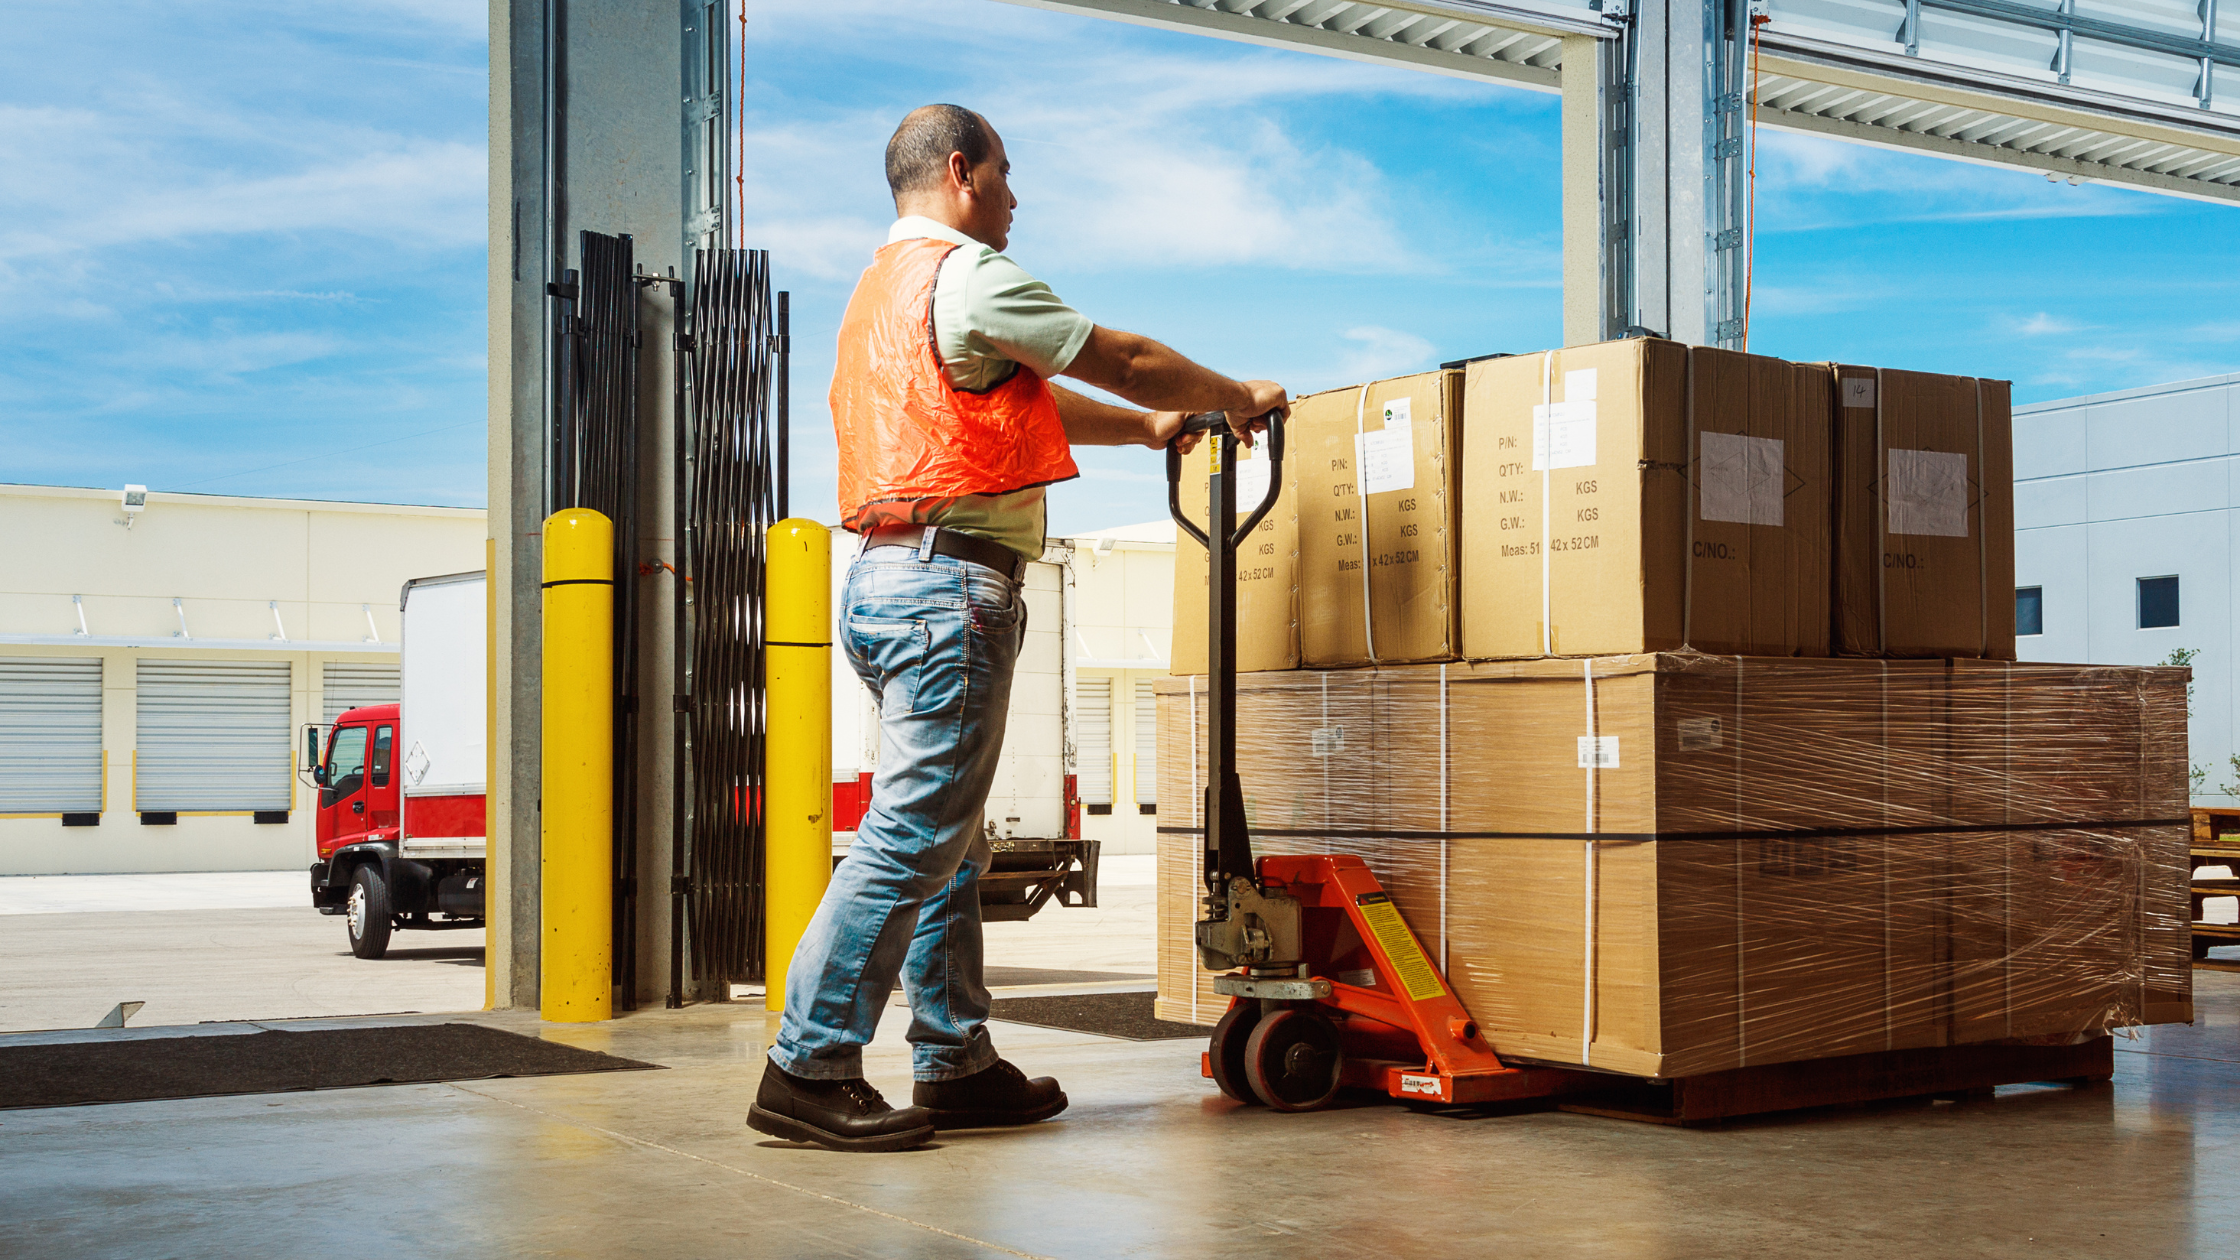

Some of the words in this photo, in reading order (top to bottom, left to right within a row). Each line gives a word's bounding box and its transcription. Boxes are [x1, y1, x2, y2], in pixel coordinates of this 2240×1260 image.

[1853, 384, 1866, 398] 14
[1499, 436, 1517, 450] P/N:
[1331, 458, 1348, 471] P/N:
[1499, 462, 1523, 477] Q'TY:
[1333, 483, 1354, 497] Q'TY:
[1499, 490, 1523, 504] N.W.:
[1576, 480, 1597, 495] KGS
[1335, 508, 1355, 521] N.W.:
[1398, 498, 1416, 512] KGS
[1258, 519, 1274, 532] KGS
[1500, 516, 1525, 530] G.W.:
[1577, 507, 1599, 522] KGS
[1336, 533, 1357, 546] G.W.:
[1400, 524, 1418, 538] KGS
[1259, 543, 1274, 555] KGS
[1501, 544, 1528, 557] Meas:
[1530, 541, 1540, 555] 51
[1551, 538, 1561, 552] 42
[1571, 536, 1582, 550] 52
[1583, 535, 1599, 549] CM
[1693, 541, 1735, 560] C/NO.:
[1338, 559, 1361, 572] Meas:
[1378, 553, 1389, 566] 42
[1395, 551, 1405, 564] 52
[1406, 550, 1419, 563] CM
[1883, 553, 1924, 569] C/NO.:
[1239, 570, 1247, 582] 42
[1253, 568, 1261, 579] 52
[1263, 567, 1274, 579] CM
